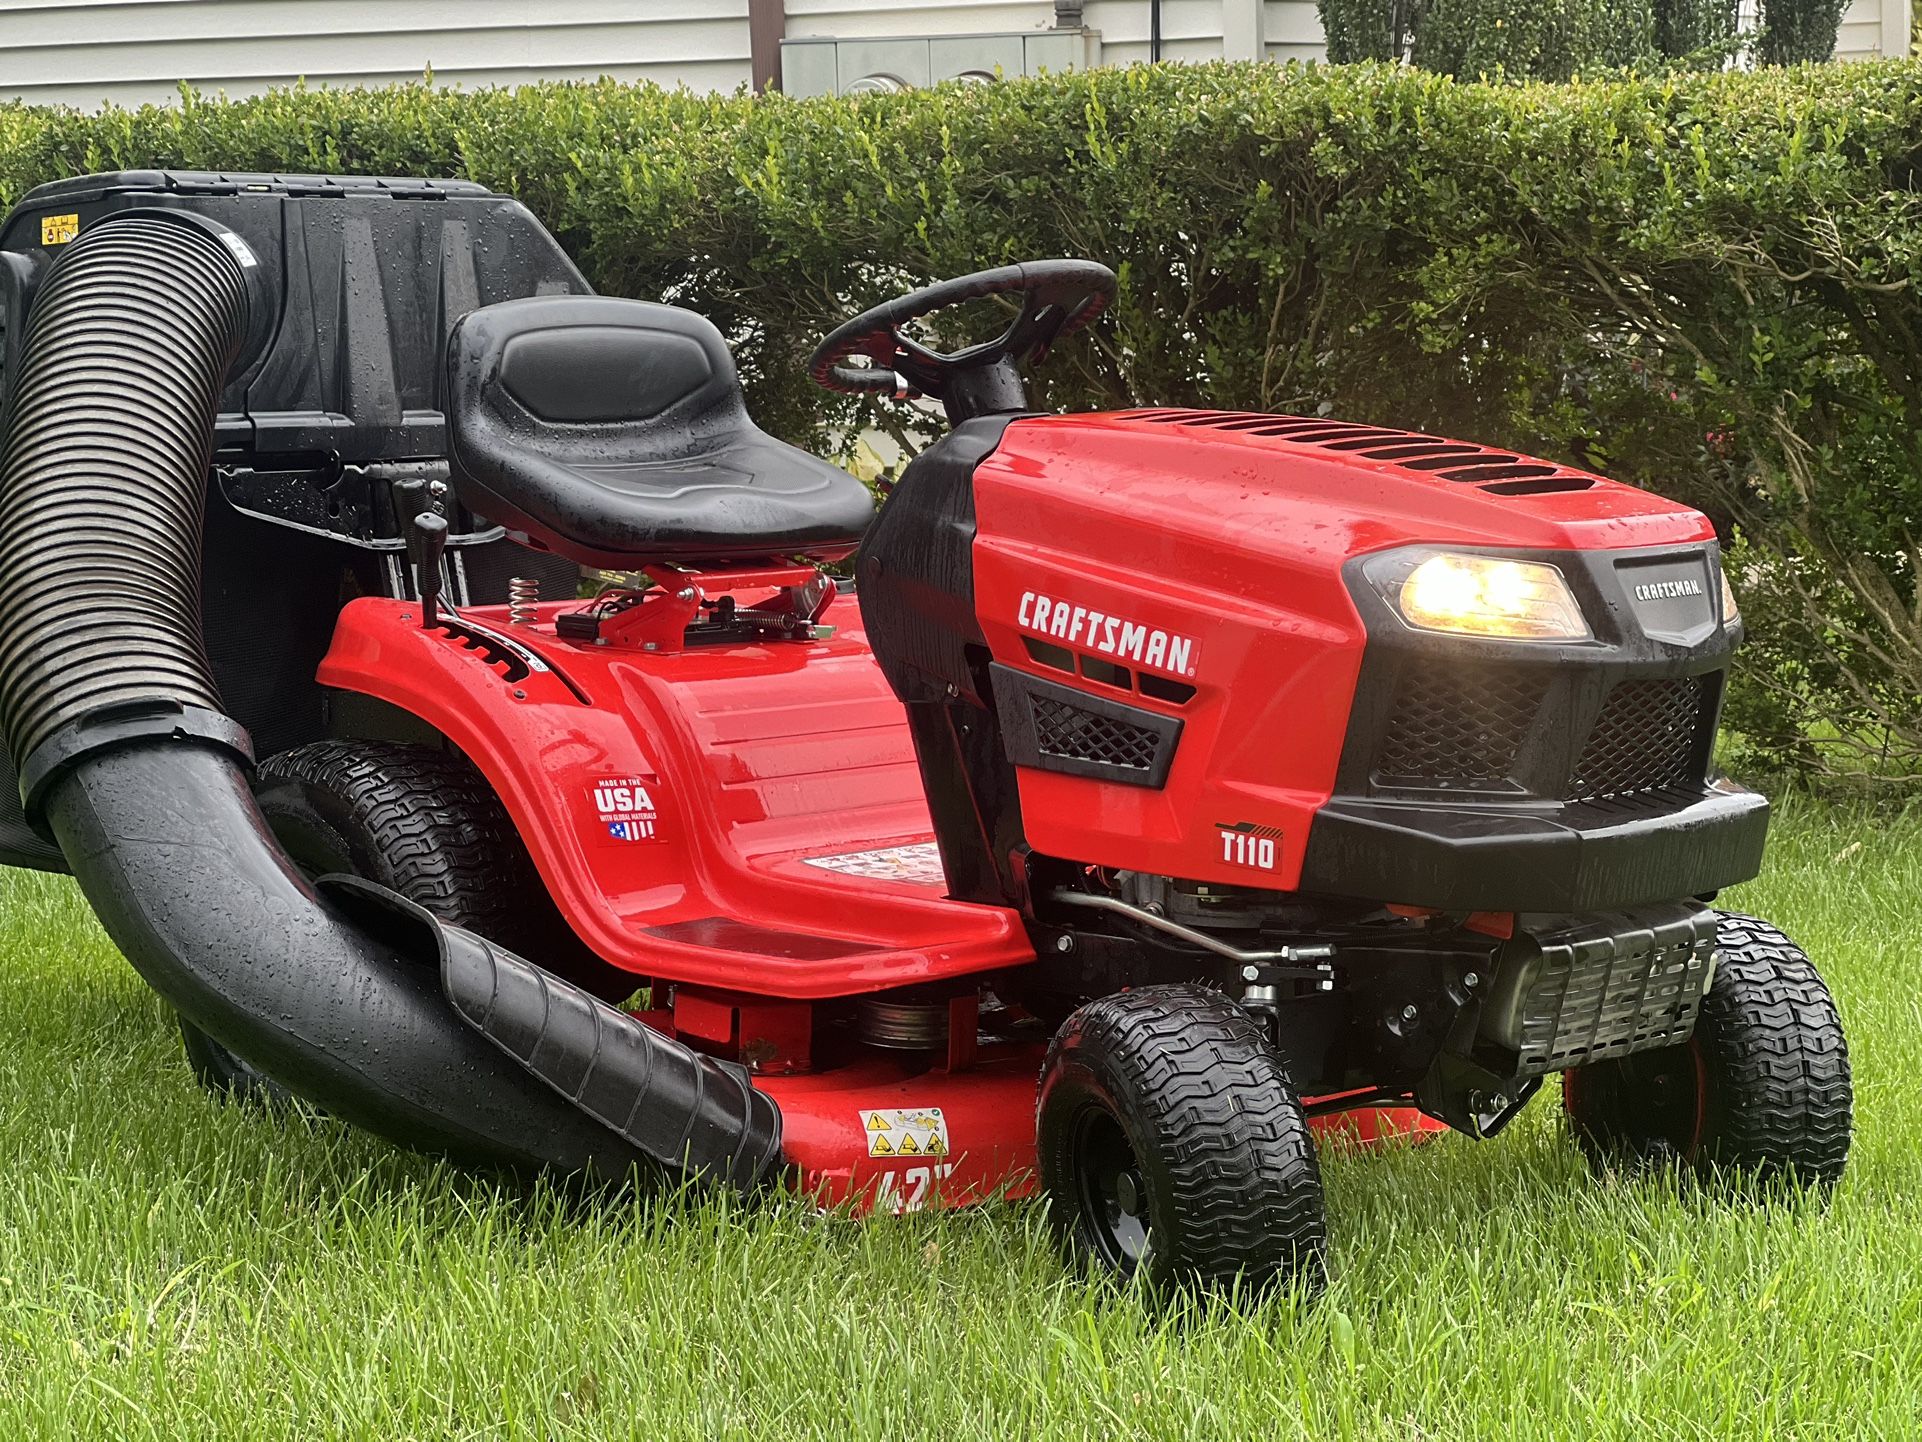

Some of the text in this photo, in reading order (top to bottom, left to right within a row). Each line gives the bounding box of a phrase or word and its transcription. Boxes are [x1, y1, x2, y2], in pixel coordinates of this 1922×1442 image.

[598, 779, 618, 787] MADE
[628, 778, 641, 786] THE
[594, 787, 655, 813] USA
[1221, 831, 1274, 869] T110
